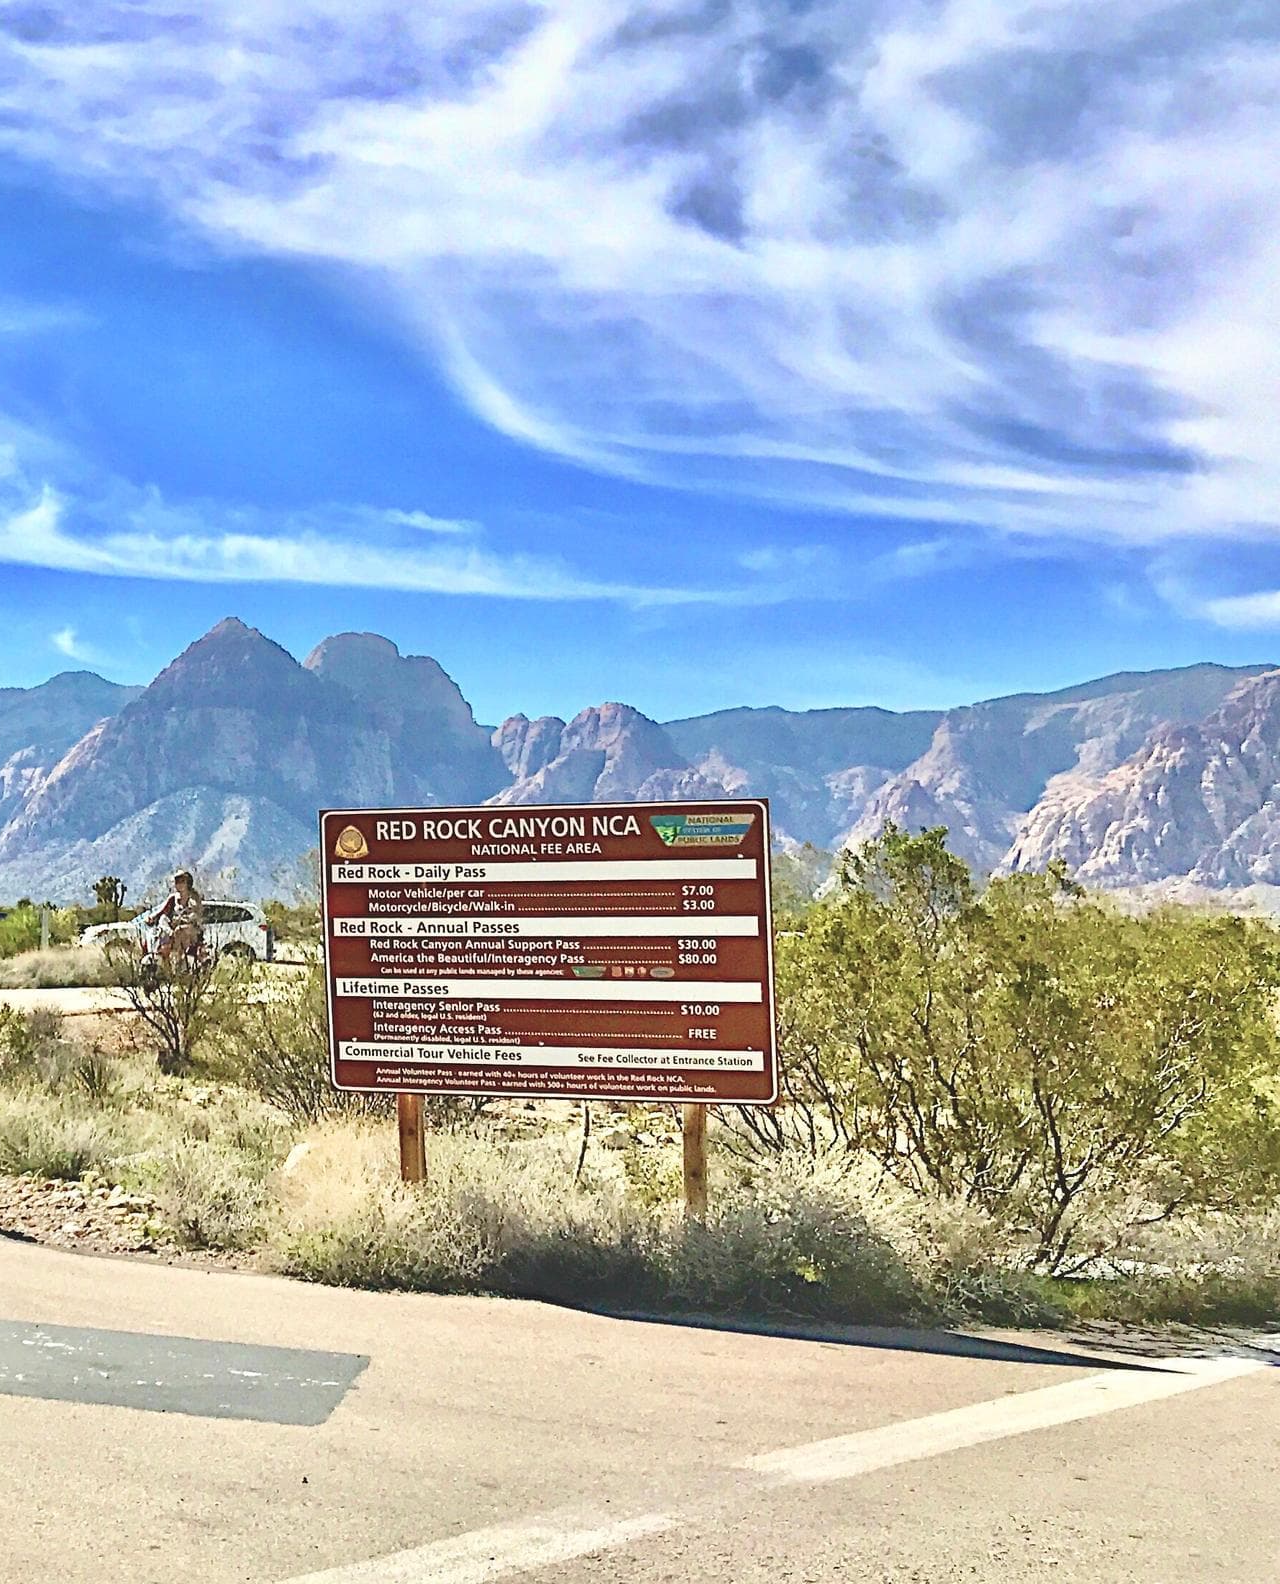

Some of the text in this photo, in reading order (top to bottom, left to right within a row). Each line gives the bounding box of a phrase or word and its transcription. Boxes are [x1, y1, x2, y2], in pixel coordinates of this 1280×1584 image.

[376, 815, 642, 841] RED ROCK CANYON NCA
[471, 842, 602, 856] NATIONAL FEE AREA
[338, 866, 363, 879] Red
[368, 866, 400, 878] Rock
[415, 866, 450, 880] Daily
[455, 866, 486, 878] Pass
[368, 888, 485, 899] Motor Vehicle/per car
[681, 885, 714, 896] $7.00
[368, 901, 515, 914] Motorcycle/Bicycle/Walk-in
[683, 899, 715, 911] $3.00
[340, 921, 365, 934] Red
[370, 921, 403, 934] Rock
[417, 921, 468, 934] Annual
[473, 921, 520, 934] Passes
[370, 939, 580, 952] Red Rock Canyon Annual Support Pass
[677, 939, 716, 950] $30.00
[371, 952, 585, 965] America the Beautiful/Interagency Pass
[678, 953, 717, 965] $80.00
[343, 982, 449, 995] Lifetime Passes
[373, 1000, 501, 1013] Interagency Senior Pass
[680, 1005, 720, 1016] $10.00
[373, 1022, 502, 1035] Interagency Access Pass
[688, 1028, 717, 1040] FREE
[345, 1046, 522, 1061] Commercial Tour Vehicle Fees
[578, 1053, 753, 1066] See Fee Collector at Entrance Station
